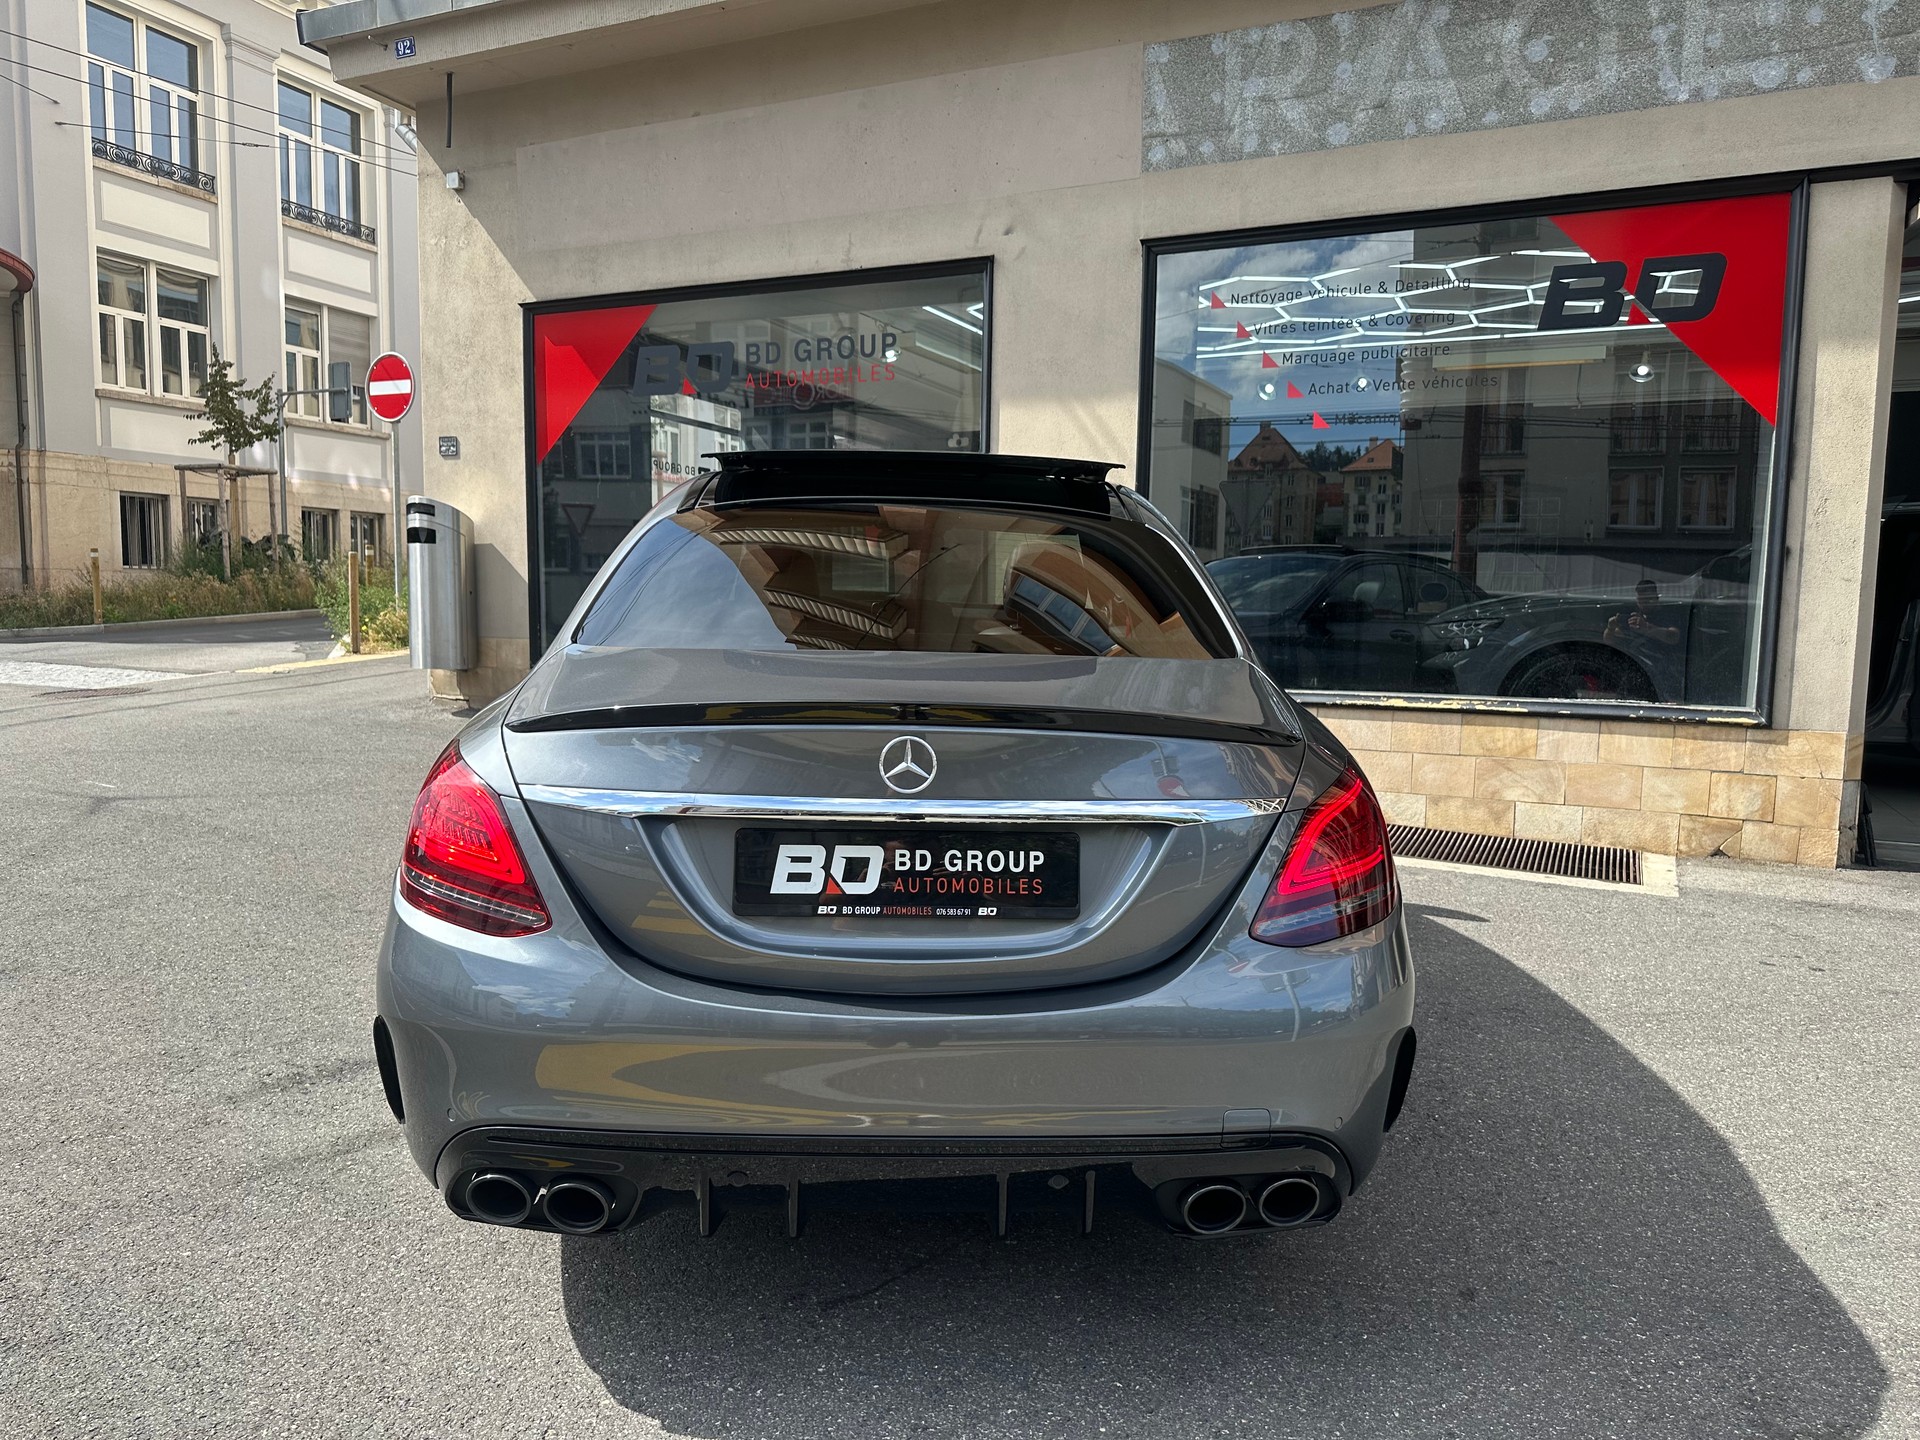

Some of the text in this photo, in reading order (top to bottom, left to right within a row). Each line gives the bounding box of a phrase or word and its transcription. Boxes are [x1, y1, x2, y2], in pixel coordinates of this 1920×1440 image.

[397, 39, 411, 55] 92
[1230, 277, 1471, 305] Nettoyage véhicule & Detailling
[1536, 252, 1728, 331] BD
[1253, 311, 1455, 335] Vitres teintées & Covering
[746, 332, 897, 365] BD GROUP
[1282, 345, 1450, 367] Marquage publicitaire
[631, 341, 735, 396] BD
[745, 364, 896, 389] AUTOMOBILES
[1308, 375, 1498, 395] Achat & Vente véhicules
[770, 844, 884, 895] BD
[894, 849, 1045, 873] BD GROUP
[893, 876, 1043, 895] AUTOMOBILES
[817, 905, 837, 915] BD
[842, 906, 853, 915] BD
[854, 906, 881, 916] GROUP
[882, 907, 932, 916] AUTOMOBILES
[936, 908, 947, 916] 076
[946, 908, 957, 916] 583
[957, 908, 964, 916] 67
[964, 908, 971, 916] 91
